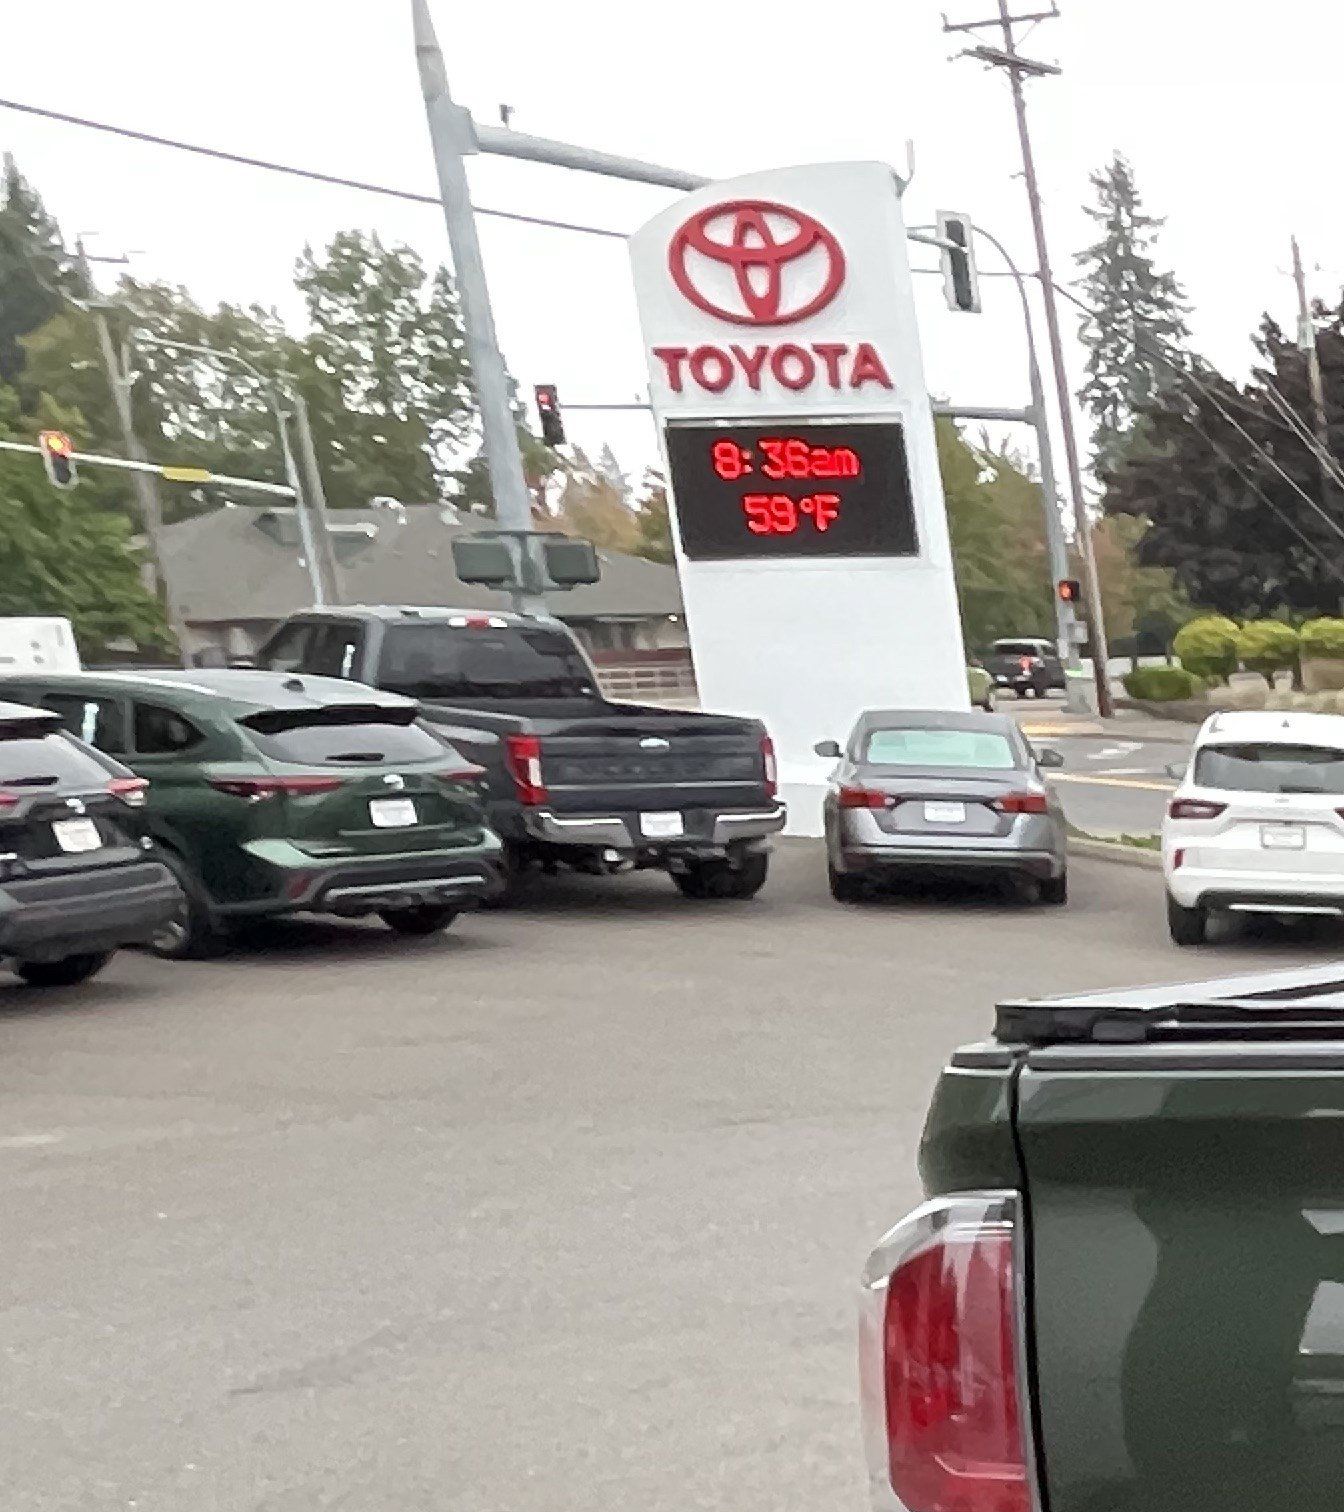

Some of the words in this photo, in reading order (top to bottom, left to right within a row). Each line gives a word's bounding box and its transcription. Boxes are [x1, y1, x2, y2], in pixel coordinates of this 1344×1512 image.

[652, 342, 894, 394] TOYOTA
[711, 438, 861, 480] 8:36am
[742, 493, 841, 533] 59°F
